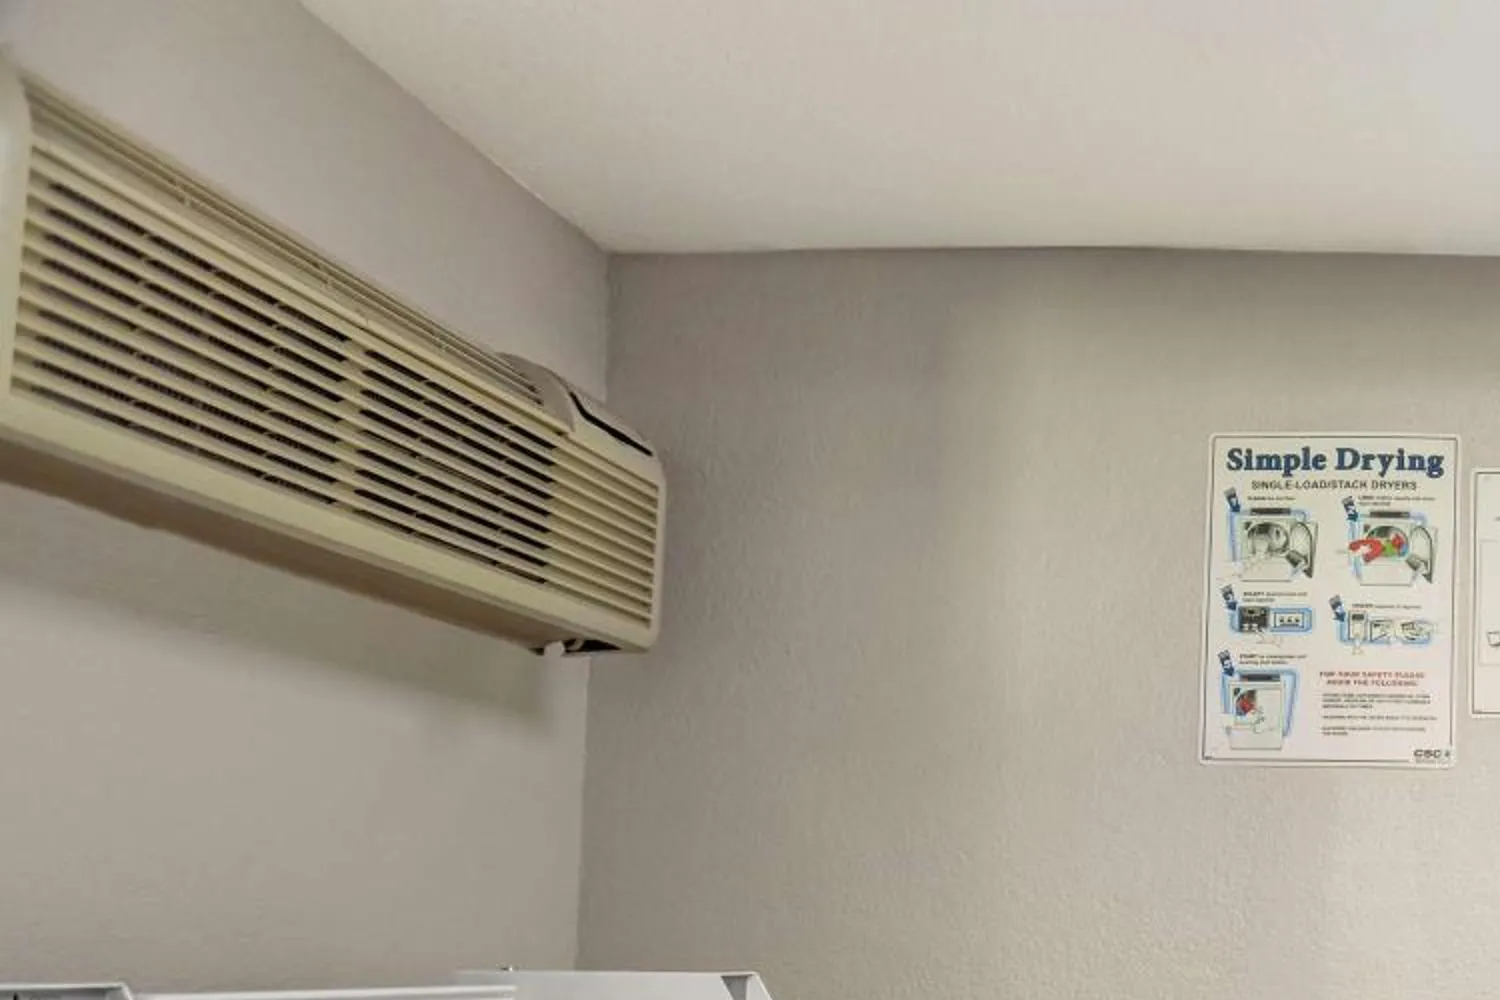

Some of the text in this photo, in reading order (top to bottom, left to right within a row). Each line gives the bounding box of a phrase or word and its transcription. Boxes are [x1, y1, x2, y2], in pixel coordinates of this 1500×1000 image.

[1226, 446, 1445, 478] Simple Drying
[1371, 480, 1417, 491] DRYERS
[1413, 749, 1441, 758] CSC
